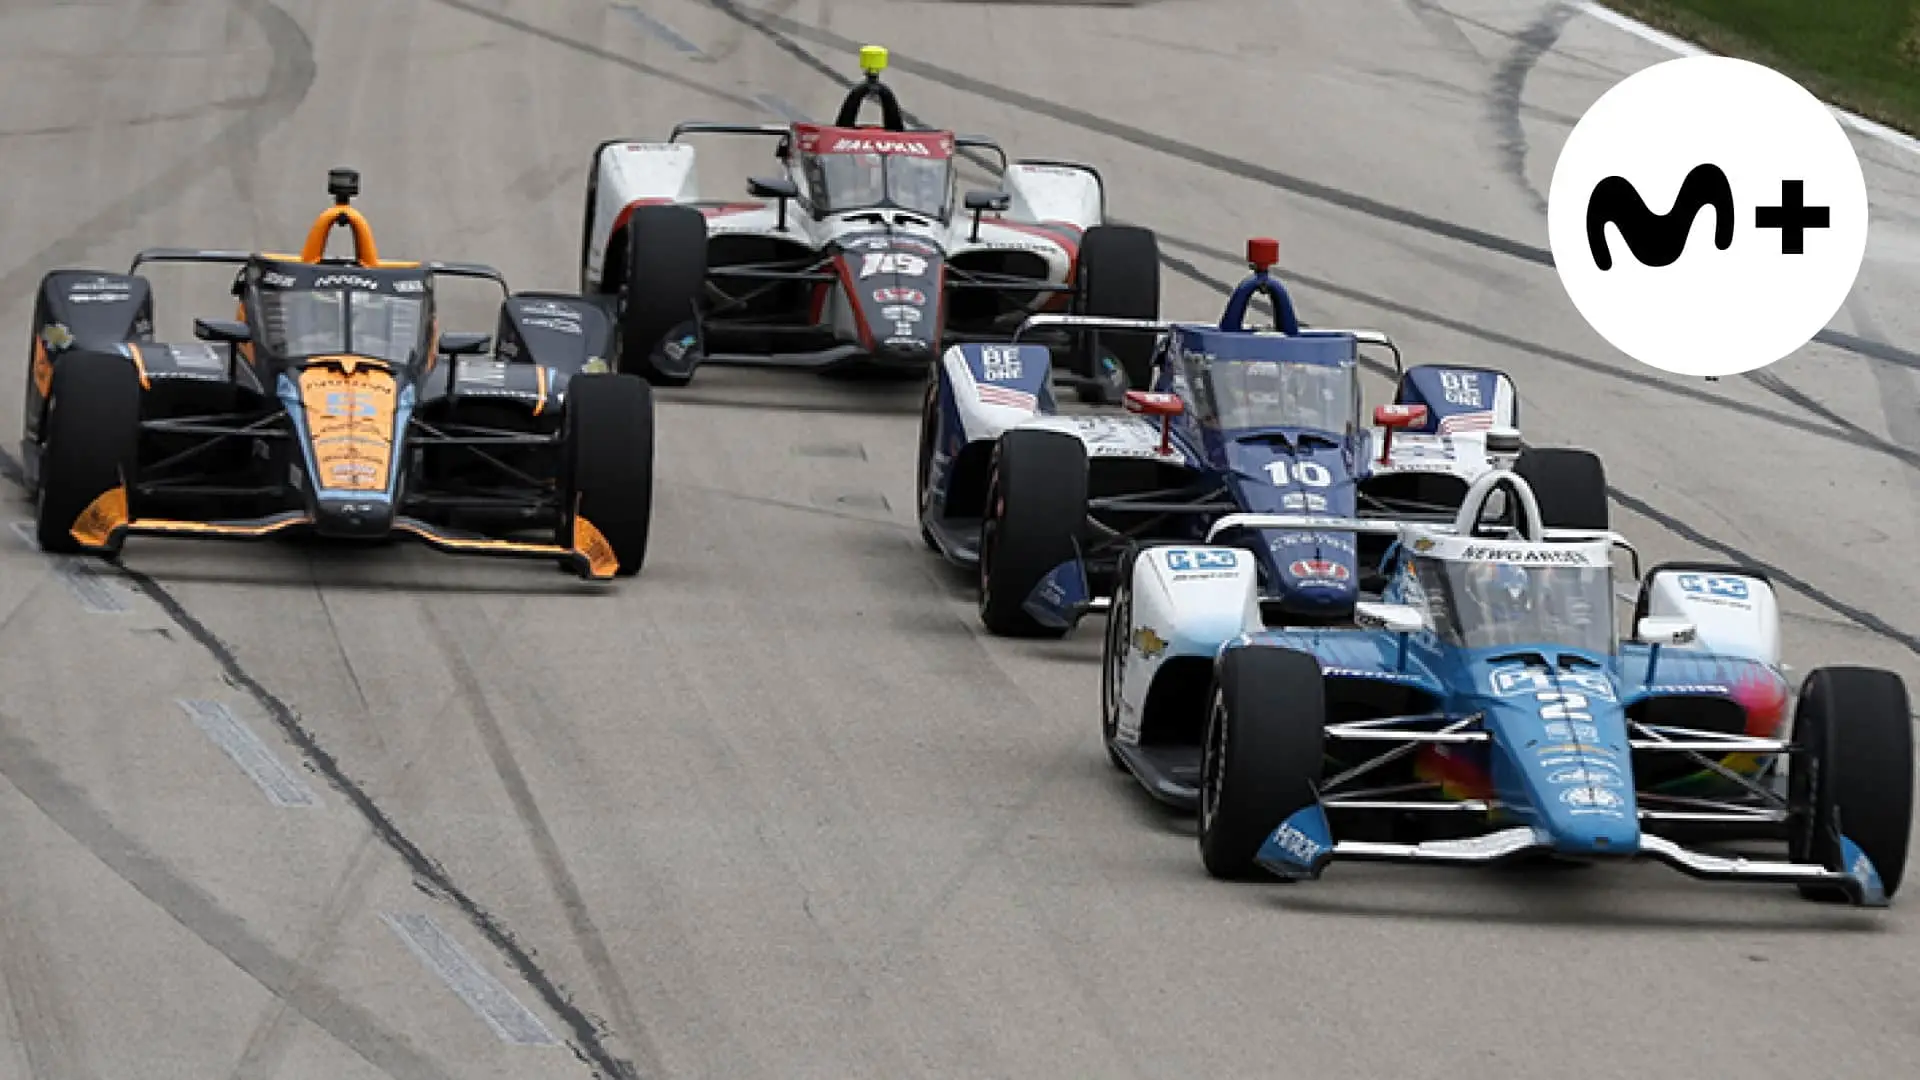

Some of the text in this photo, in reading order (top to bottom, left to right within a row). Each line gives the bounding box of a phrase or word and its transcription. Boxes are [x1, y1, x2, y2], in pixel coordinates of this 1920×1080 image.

[325, 392, 376, 416] 5
[1264, 460, 1331, 487] 10
[1535, 693, 1593, 721] 2
